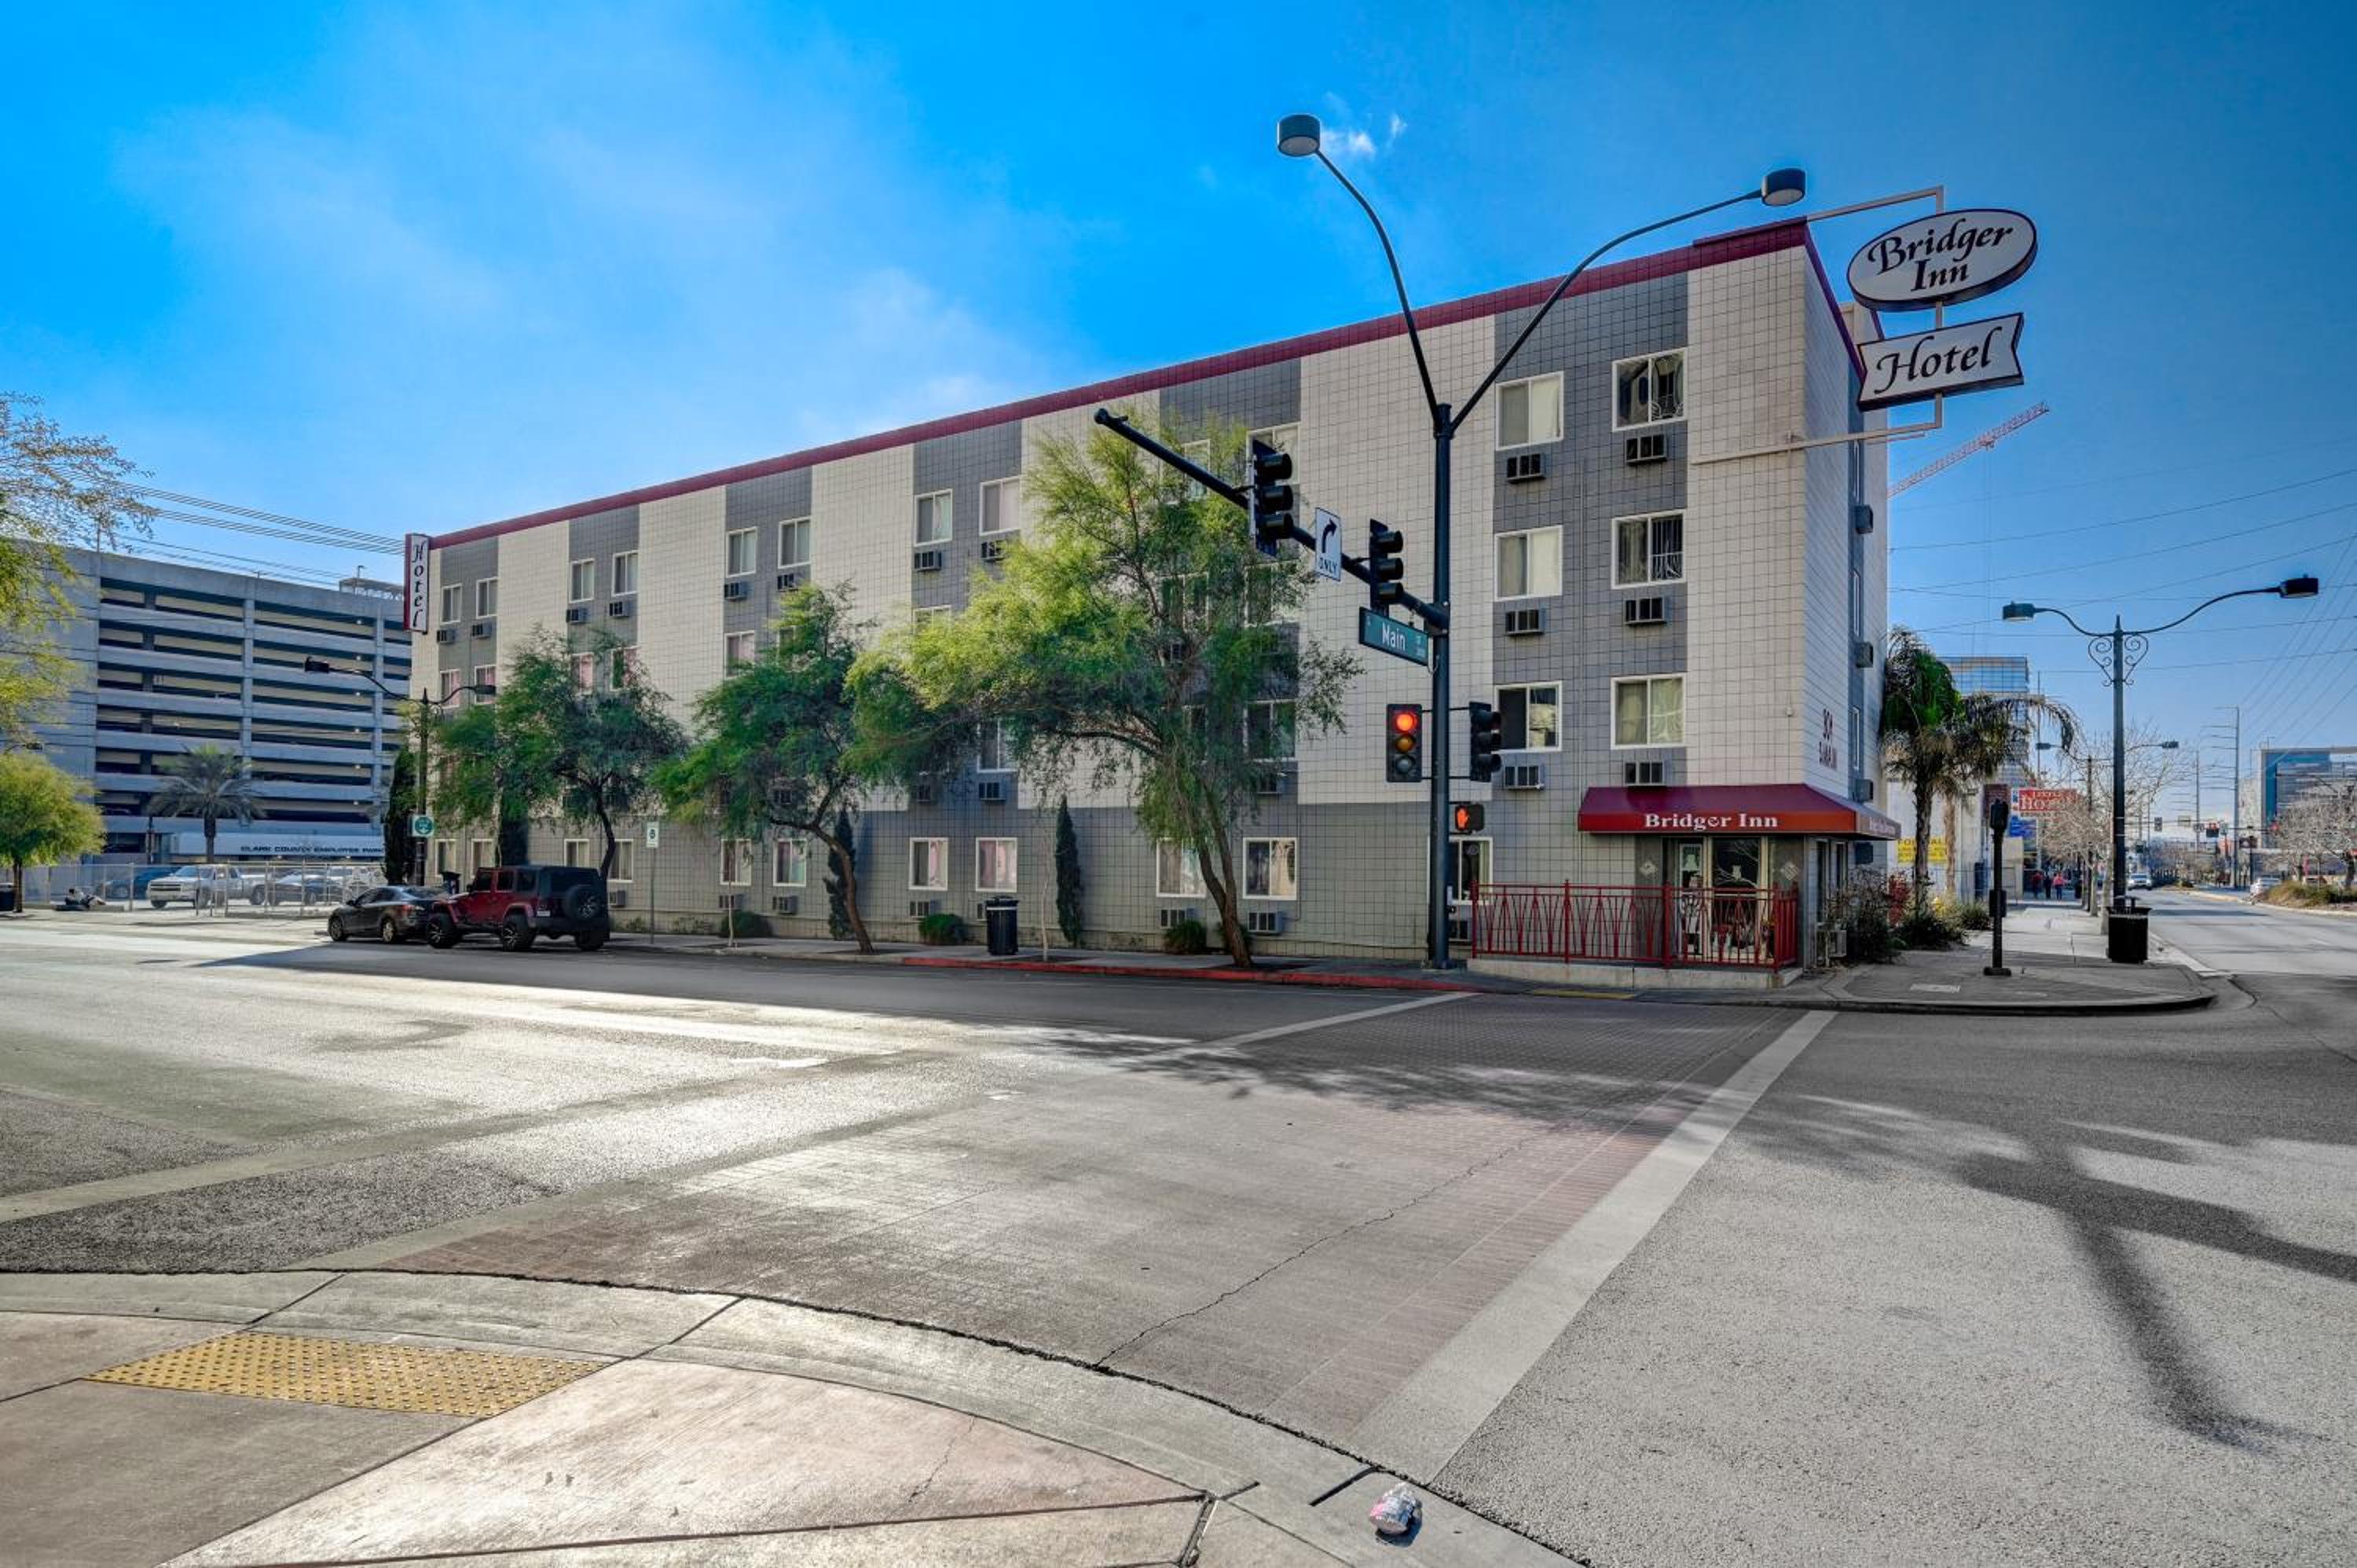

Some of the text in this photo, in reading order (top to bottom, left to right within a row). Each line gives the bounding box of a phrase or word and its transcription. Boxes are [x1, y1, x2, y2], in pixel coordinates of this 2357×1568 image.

[1868, 218, 2014, 275] Bridger
[1911, 258, 1970, 291] Inn
[1874, 326, 2003, 394] Hotel
[1318, 557, 1337, 575] ONLY
[412, 540, 427, 628] Hotel
[1382, 621, 1406, 651] Main
[1644, 813, 1778, 832] Bridger Inn
